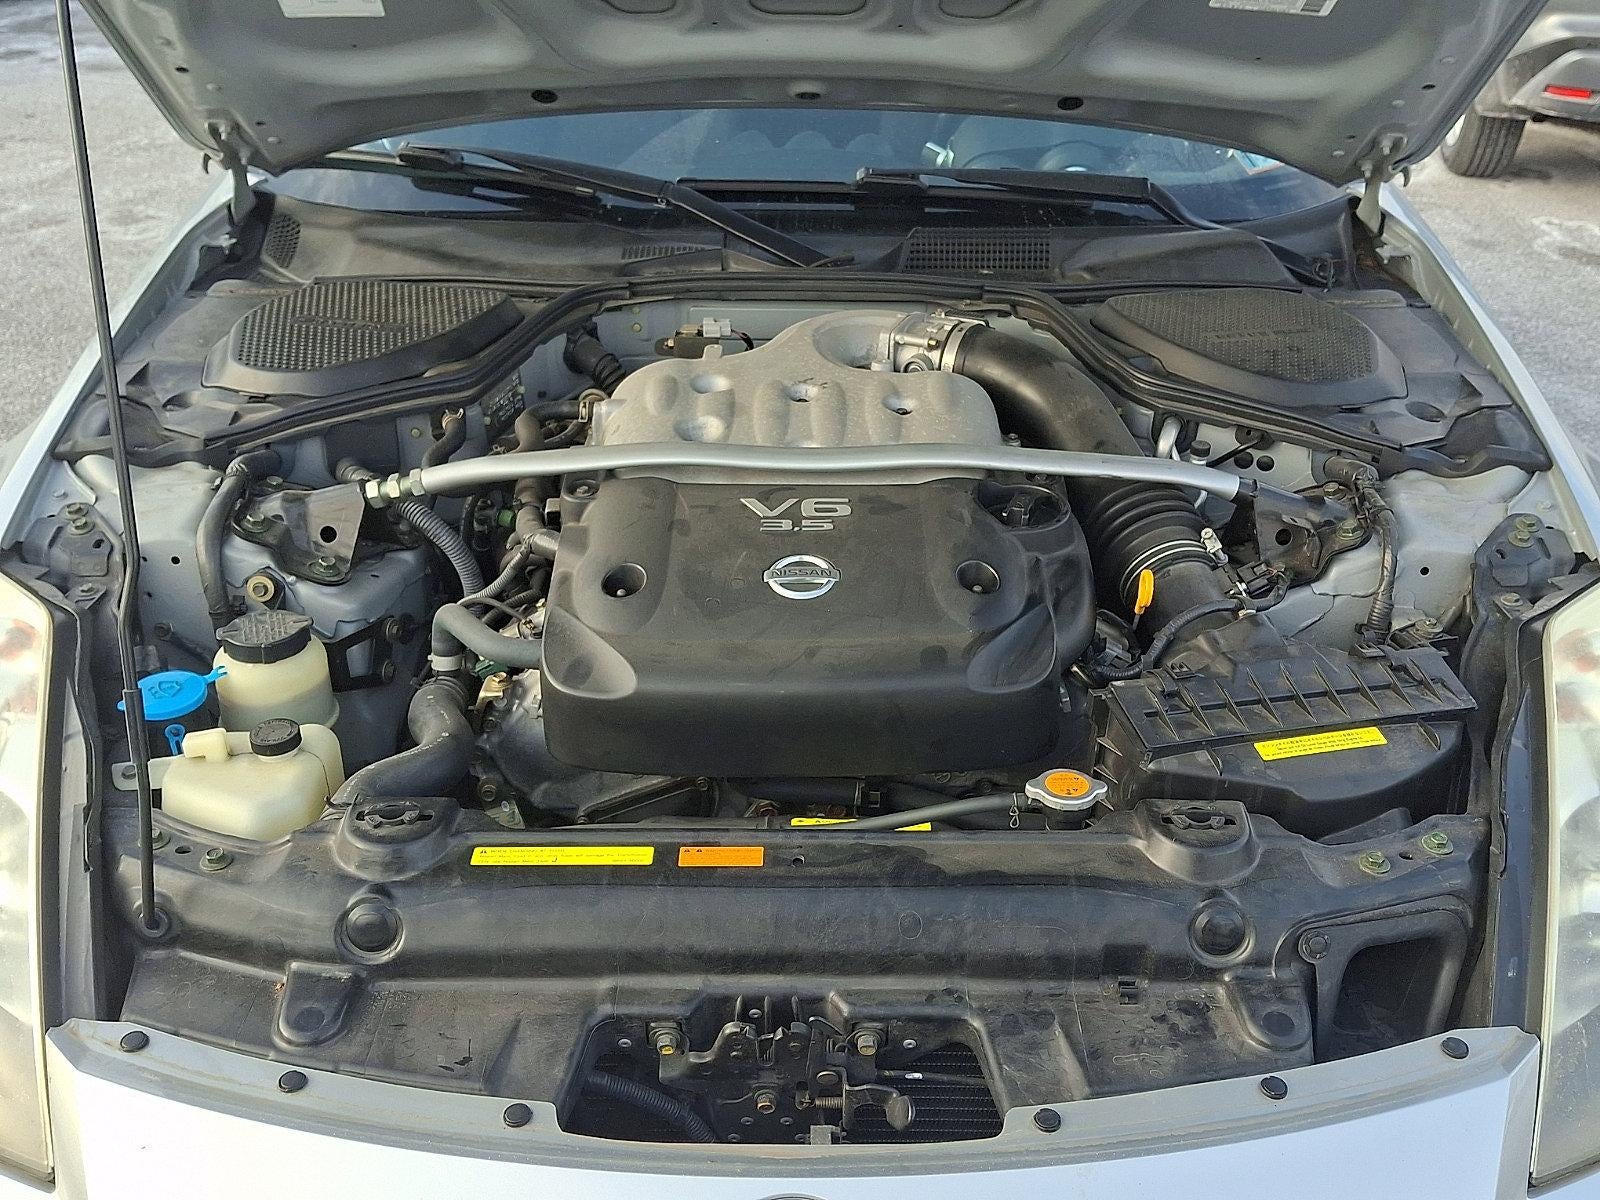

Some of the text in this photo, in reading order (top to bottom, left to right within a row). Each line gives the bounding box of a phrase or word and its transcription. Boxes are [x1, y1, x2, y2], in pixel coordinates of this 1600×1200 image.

[740, 498, 852, 518] V6
[760, 519, 834, 531] 3.5
[771, 569, 832, 577] NISSAN
